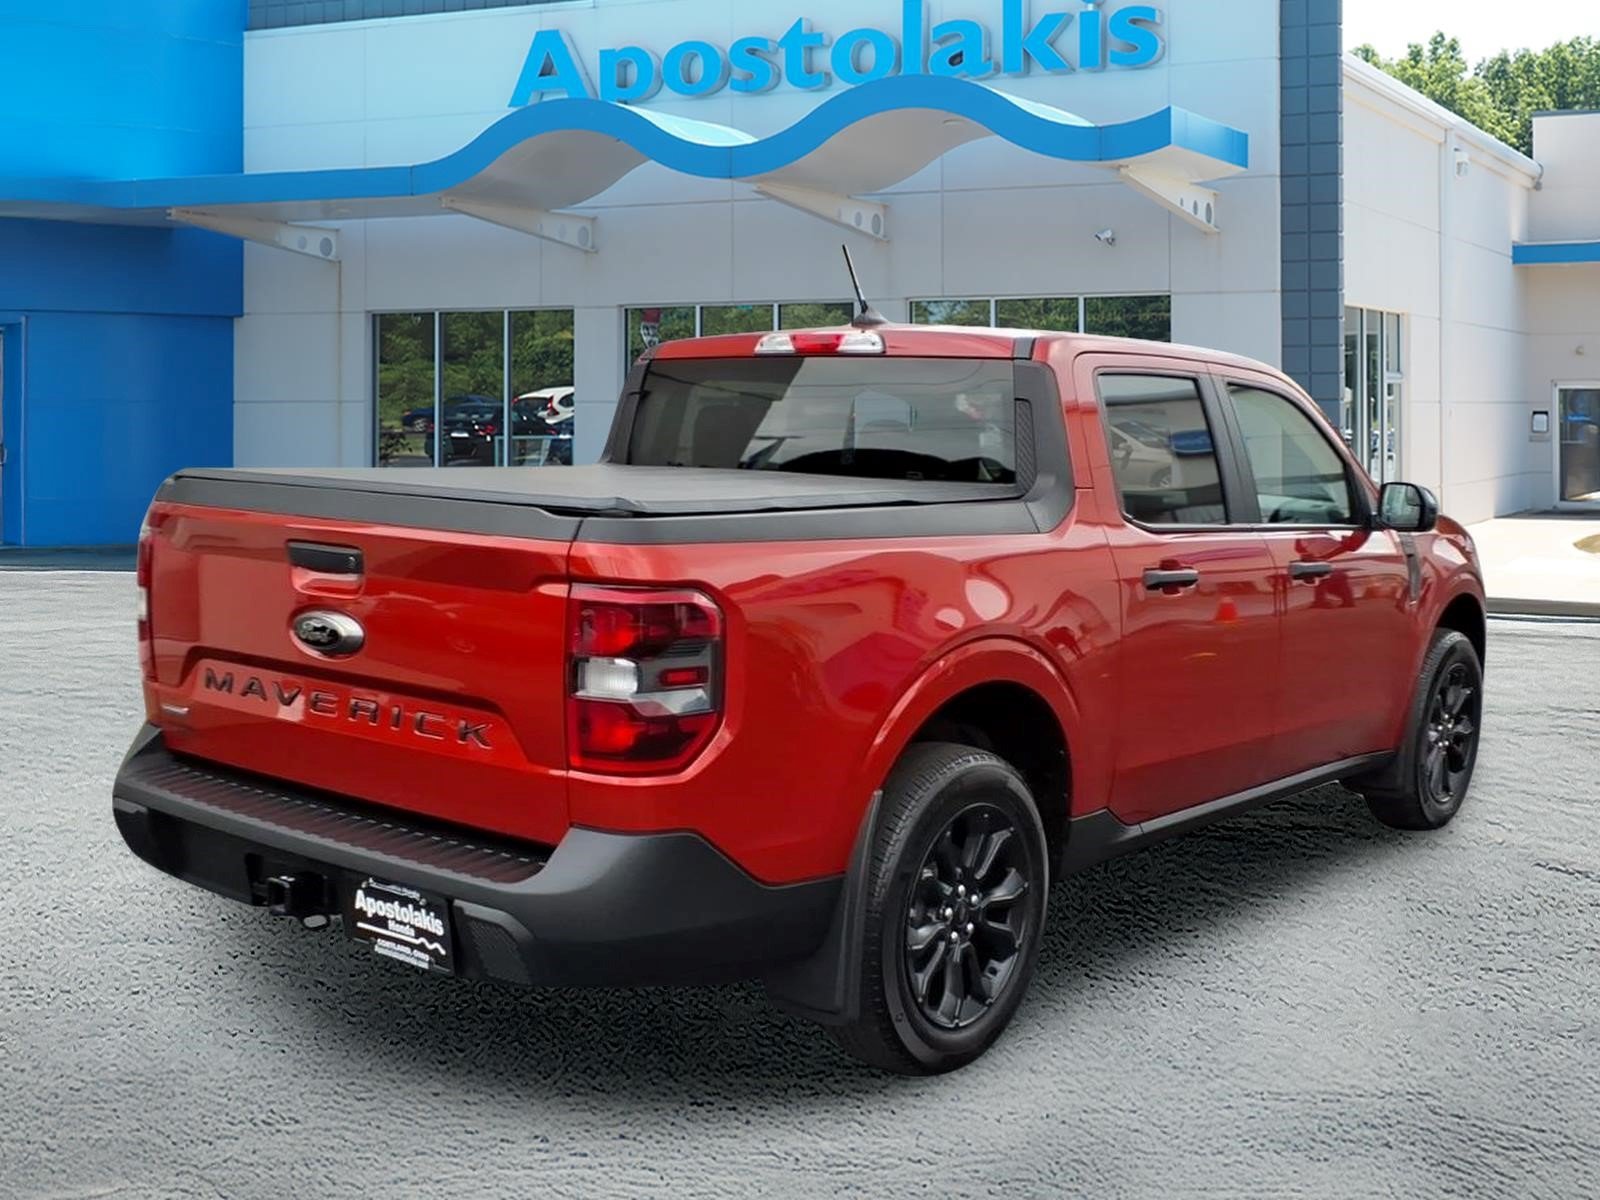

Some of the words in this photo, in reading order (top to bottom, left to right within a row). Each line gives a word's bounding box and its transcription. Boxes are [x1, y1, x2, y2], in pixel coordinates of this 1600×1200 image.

[508, 0, 1164, 109] Apostolakis
[203, 667, 494, 751] MAVERICK
[354, 889, 444, 936] Apostolakis
